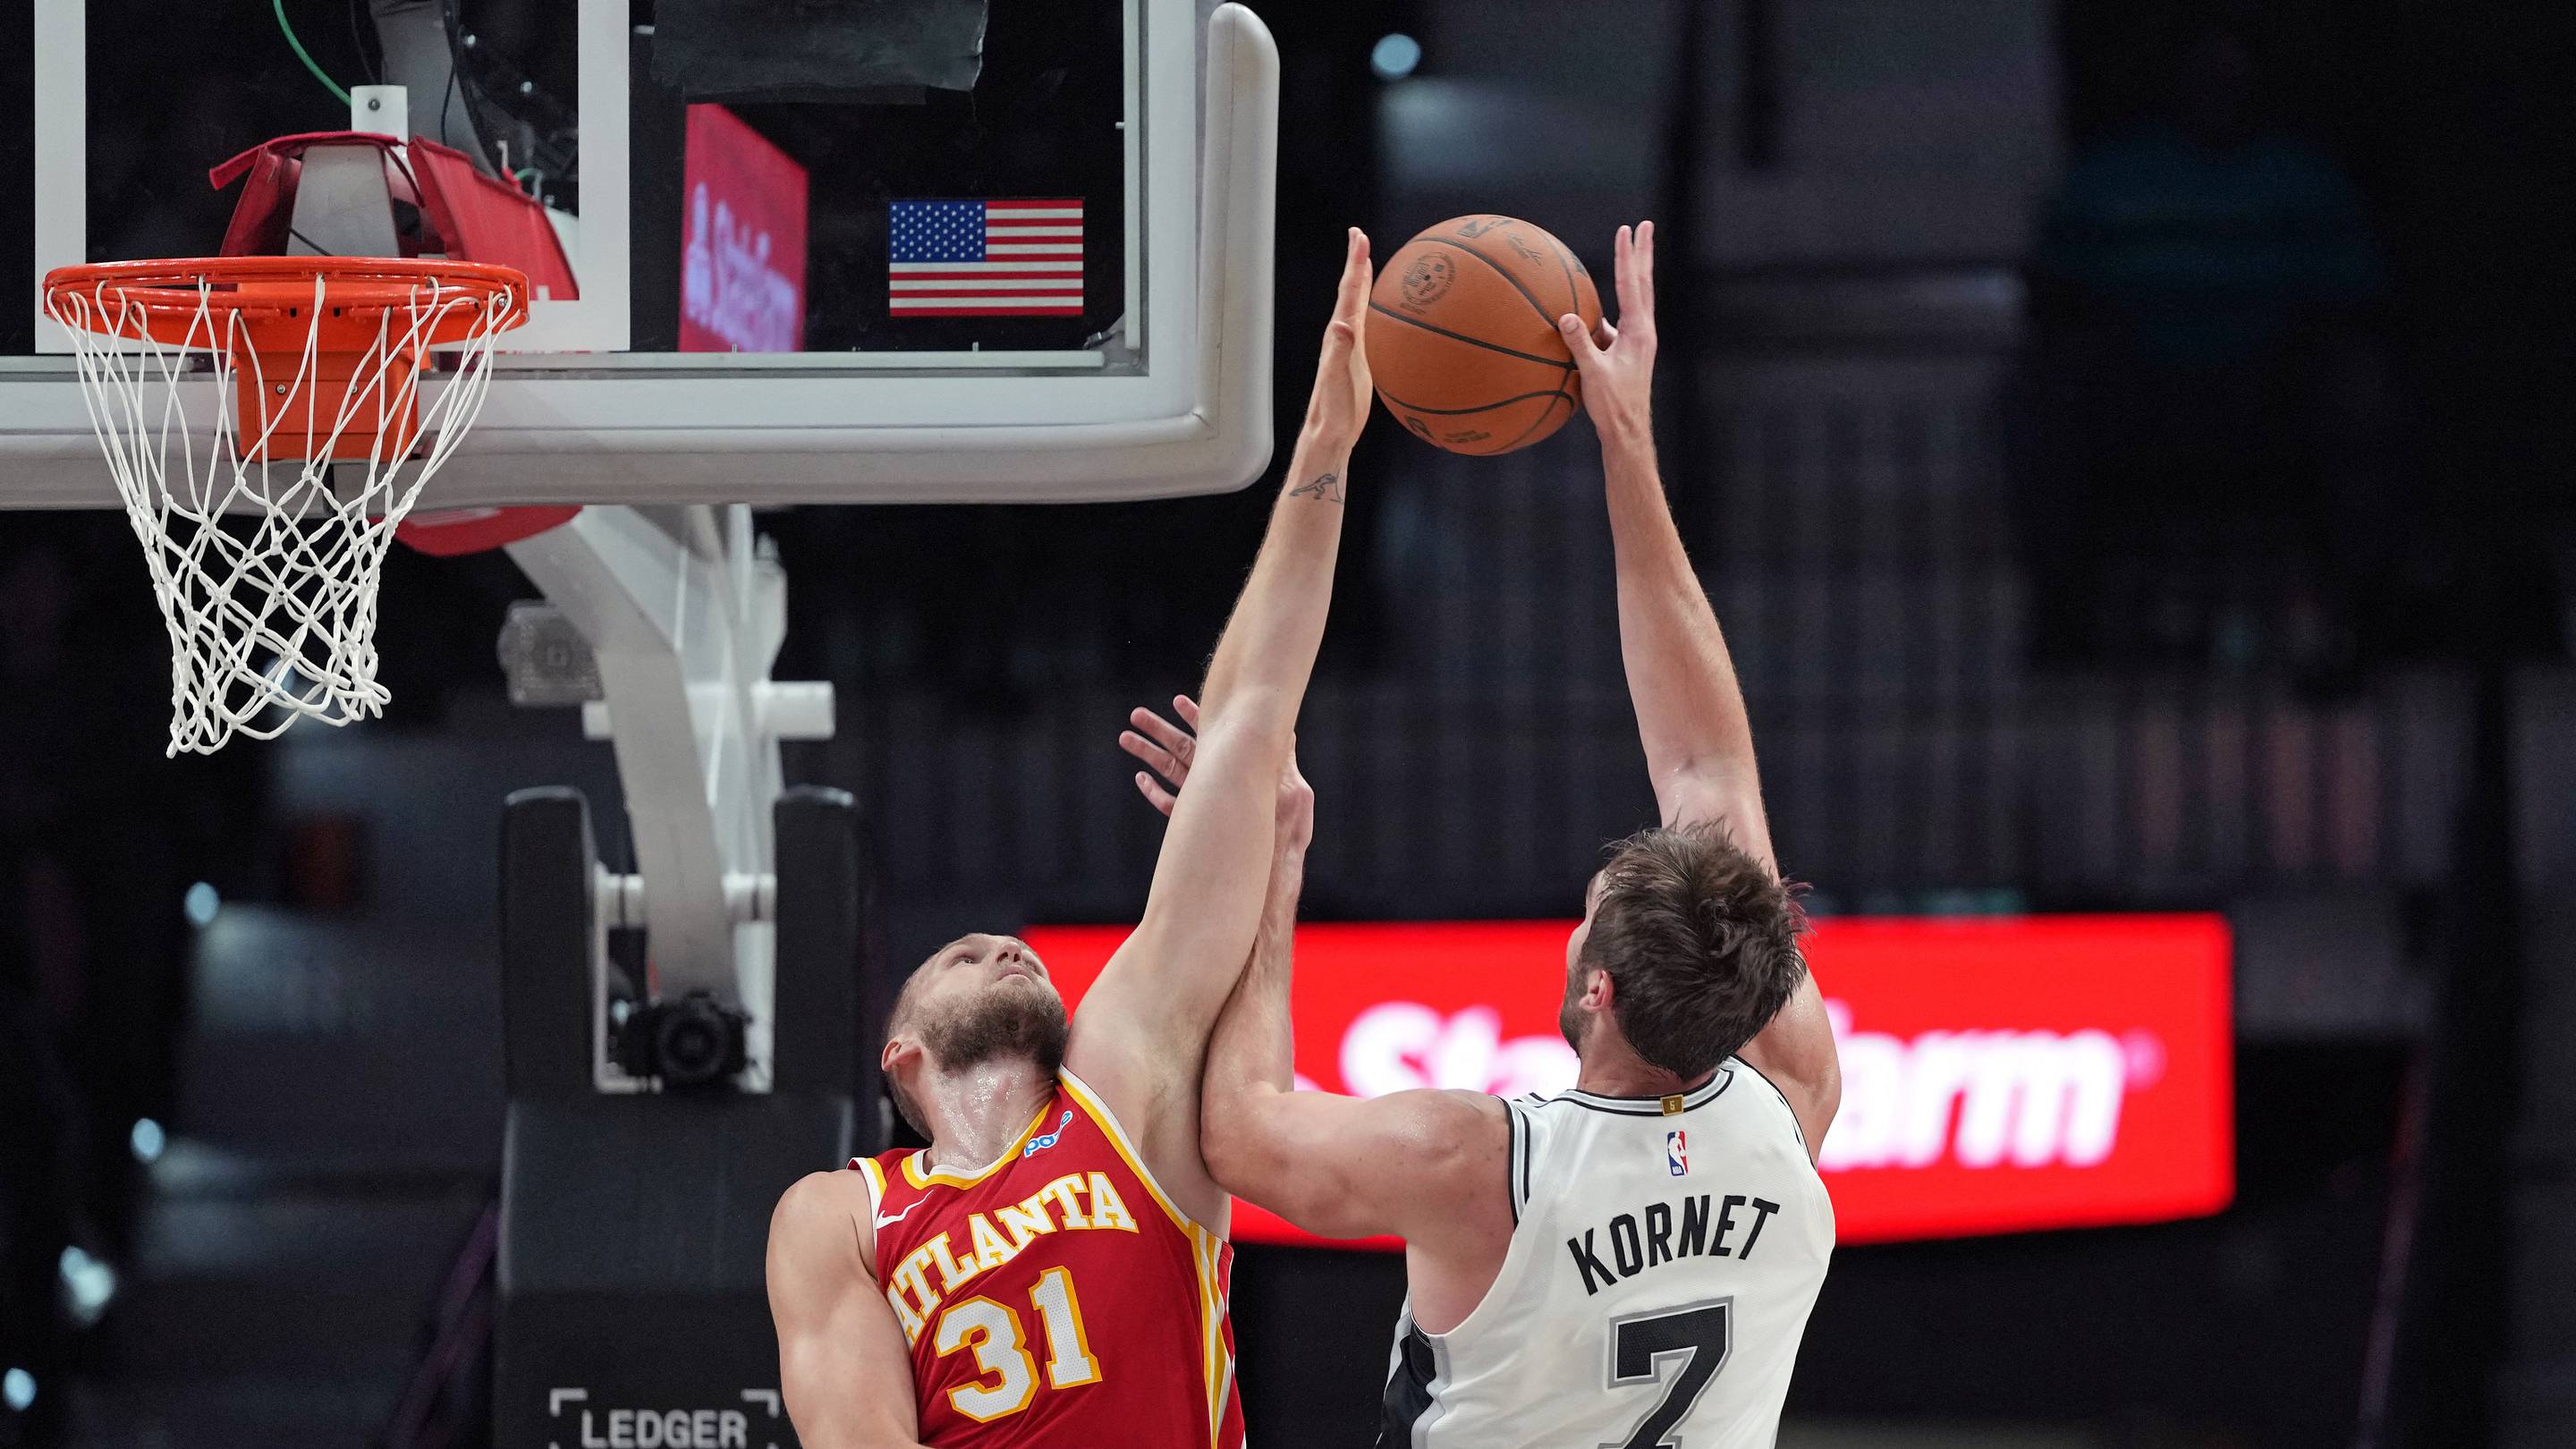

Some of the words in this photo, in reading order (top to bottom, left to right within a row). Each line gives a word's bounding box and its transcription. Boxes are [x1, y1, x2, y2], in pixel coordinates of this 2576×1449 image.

[886, 1171, 1140, 1349] ATLANTA
[1567, 1195, 1780, 1296] KORNET
[933, 1265, 1103, 1423] 31
[1599, 1296, 1734, 1449] 7
[581, 1409, 747, 1448] LEDGER
